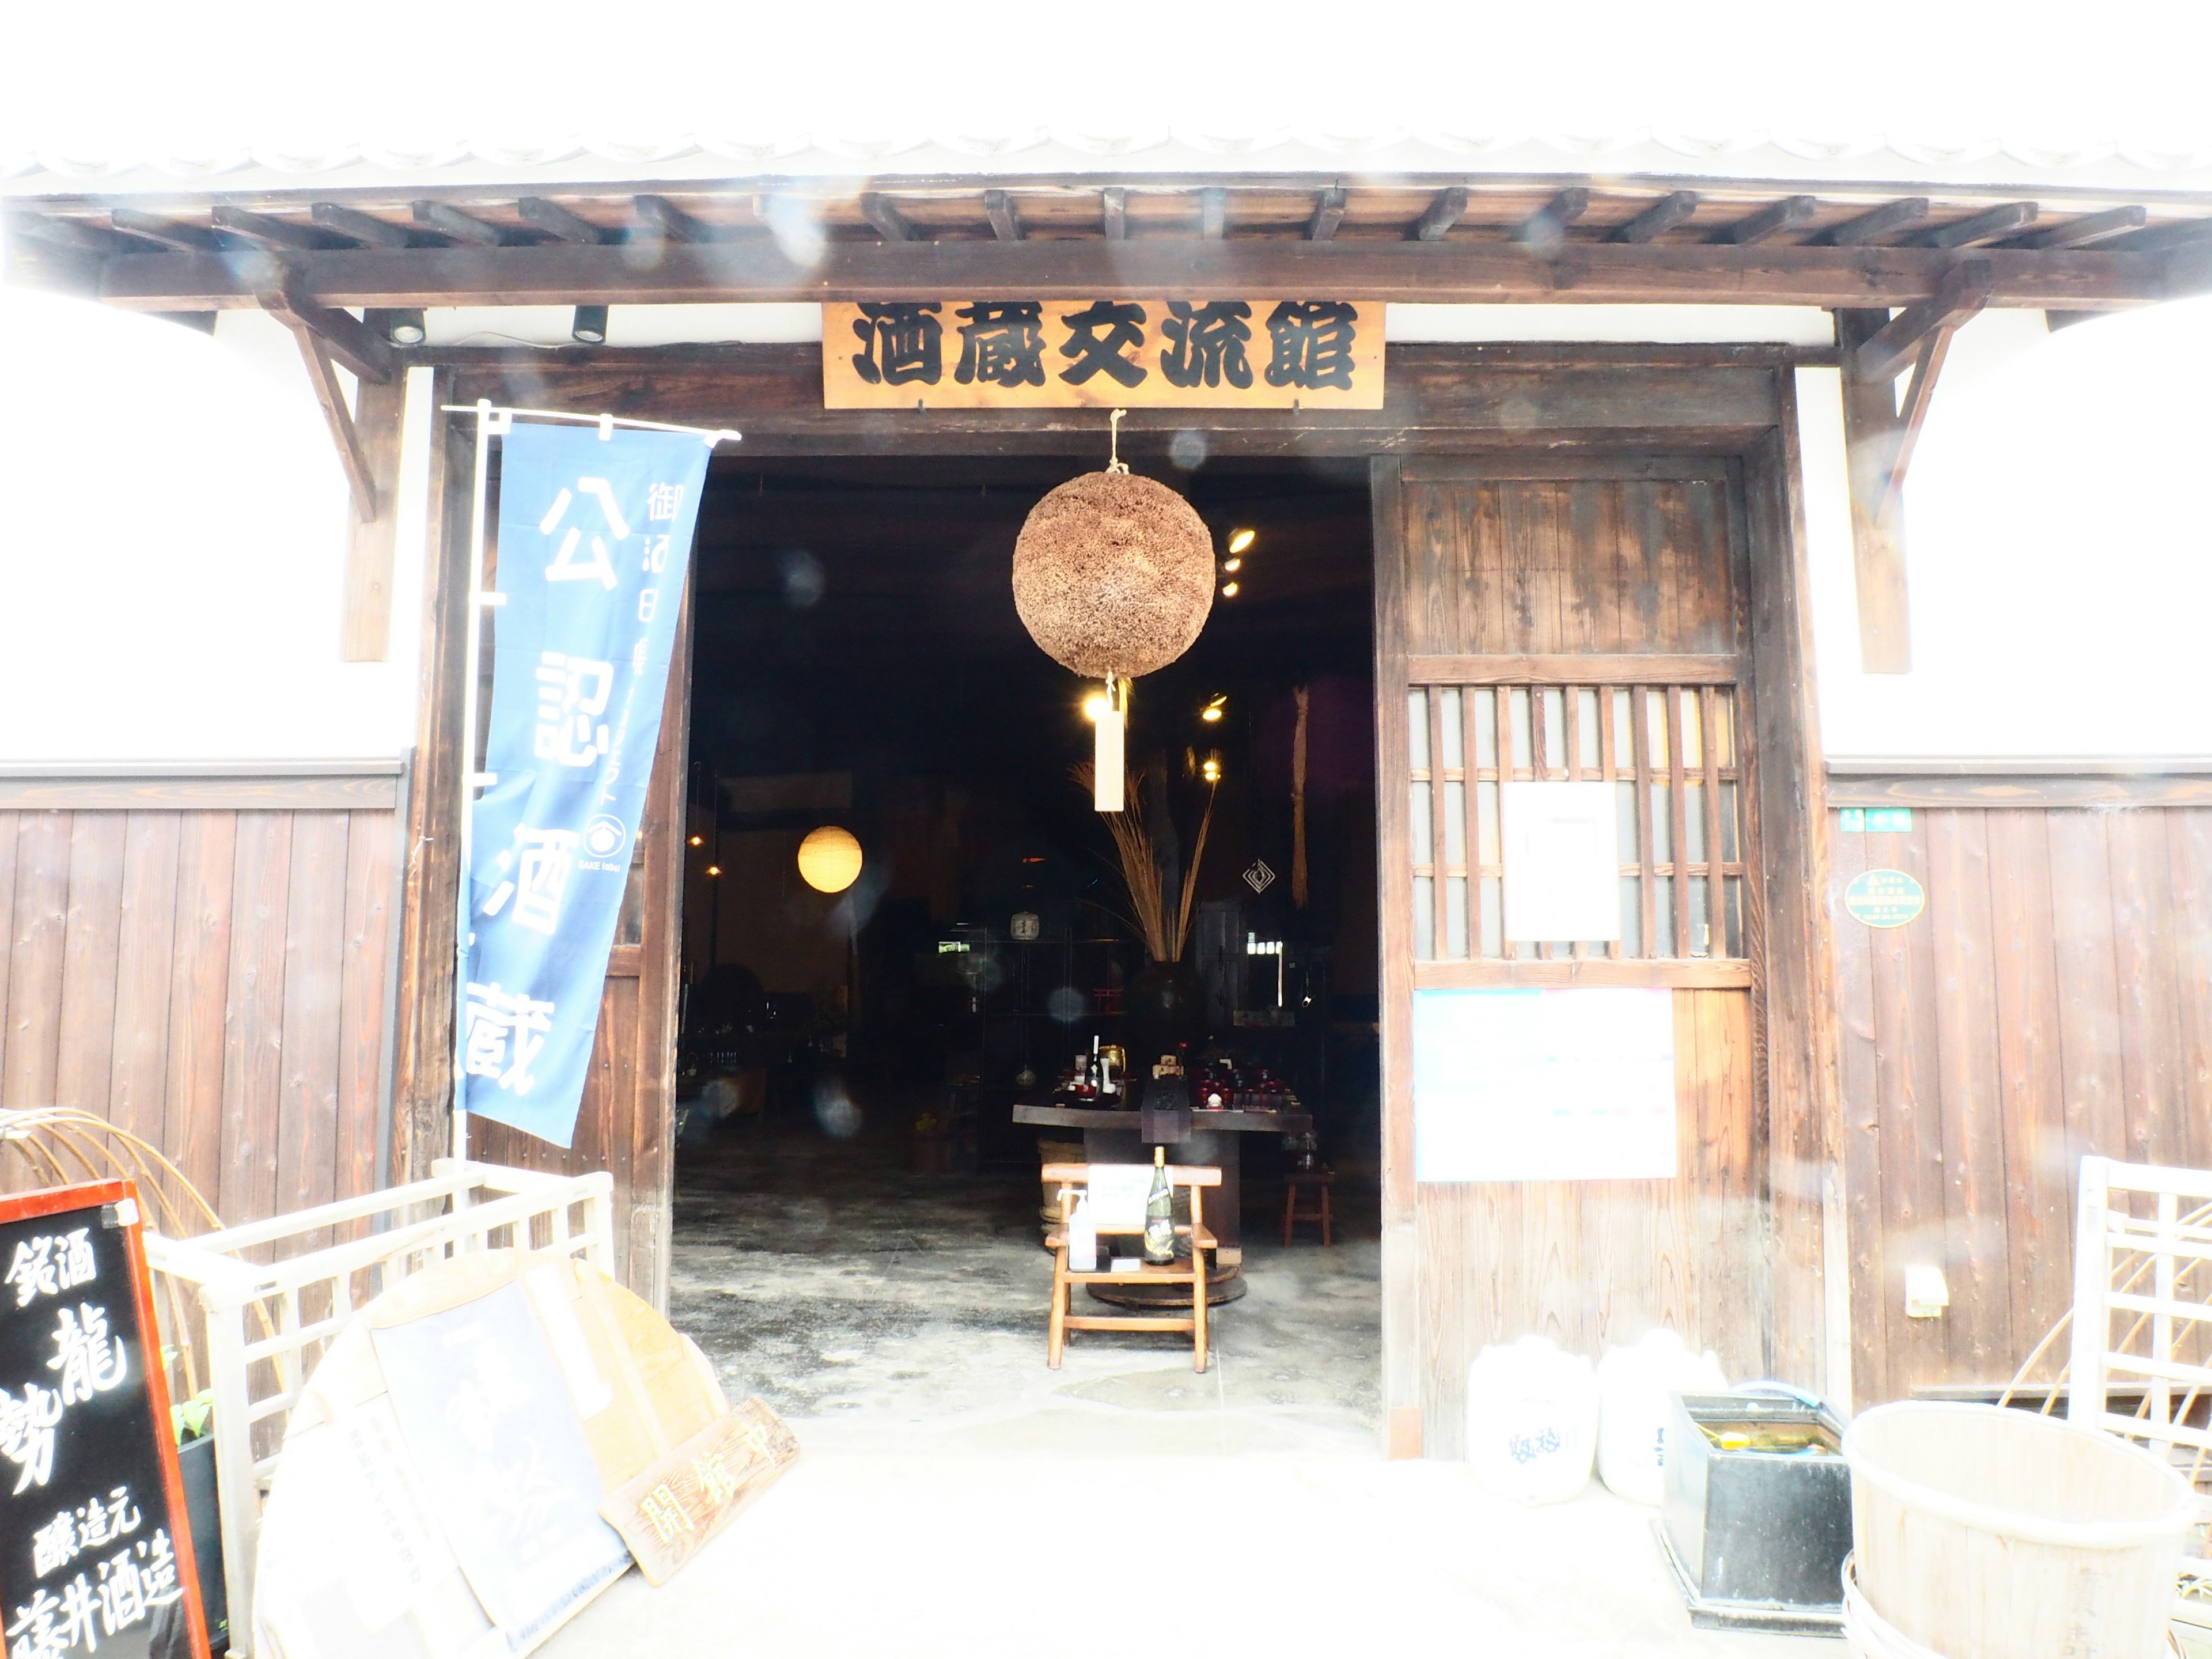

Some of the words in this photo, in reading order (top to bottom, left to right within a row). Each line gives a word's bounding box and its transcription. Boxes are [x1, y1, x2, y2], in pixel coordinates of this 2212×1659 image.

[852, 301, 1359, 391] 酒蔵交流館
[465, 477, 630, 1095] 公認酒蔵
[578, 860, 600, 870] SAKE
[601, 862, 620, 872] label
[5, 1228, 97, 1306] 銘酒
[640, 1423, 777, 1544] 開館中
